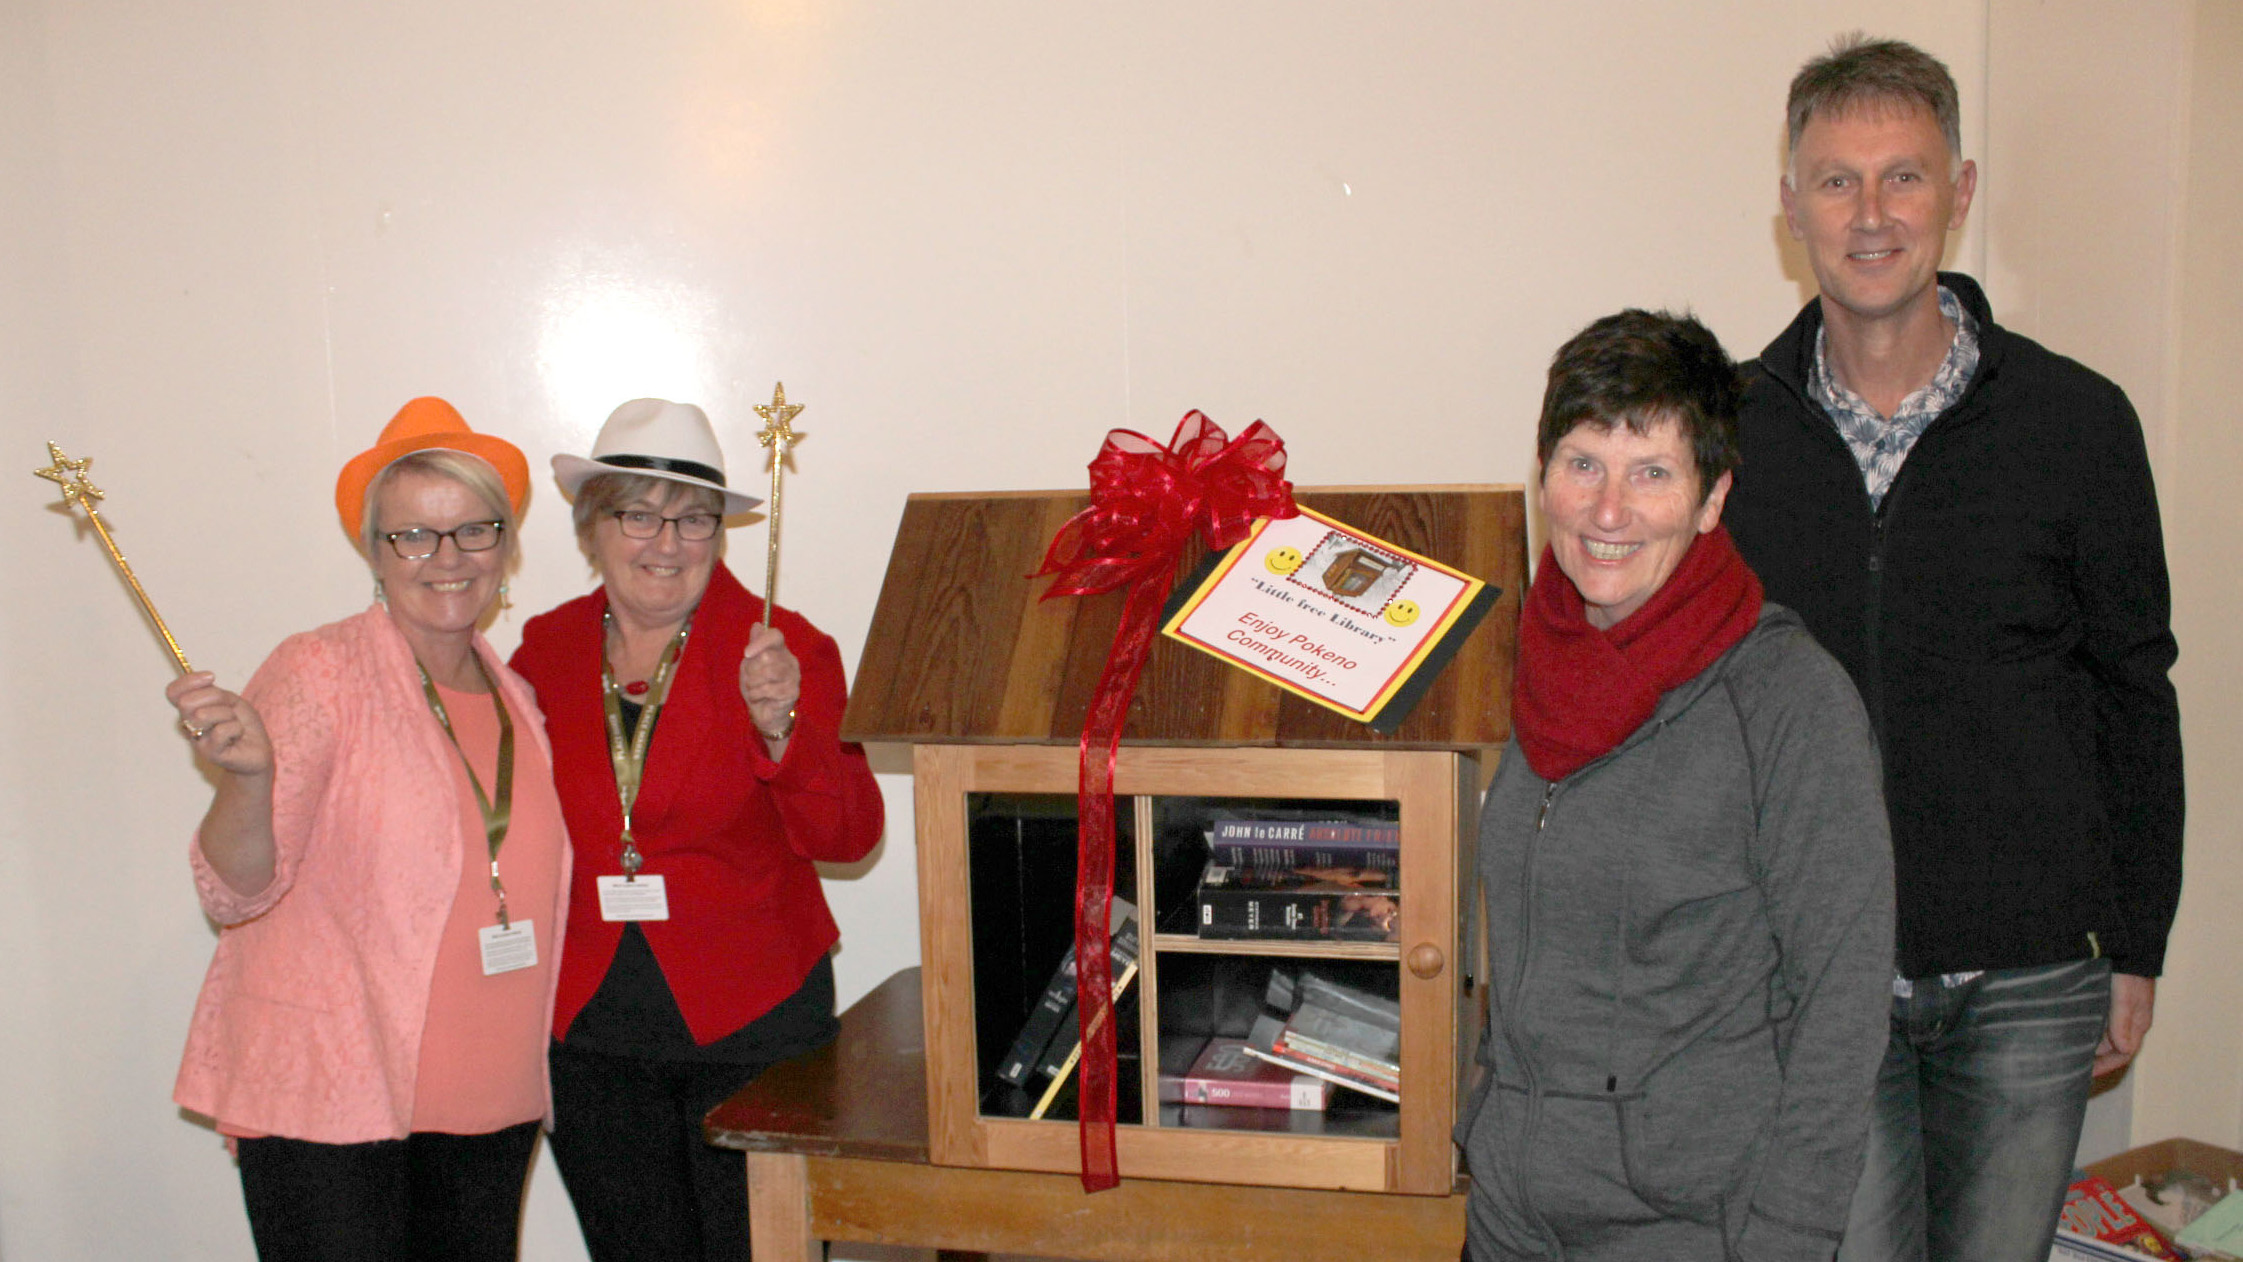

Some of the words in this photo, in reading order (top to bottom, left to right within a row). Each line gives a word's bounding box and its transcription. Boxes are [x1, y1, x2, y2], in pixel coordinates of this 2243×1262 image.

[1297, 598, 1326, 617] free
[1226, 629, 1336, 687] Community...
[1238, 611, 1290, 640] Enjoy
[1288, 634, 1358, 670] Pokeno
[1221, 825, 1252, 839] JOHN
[1254, 826, 1266, 839] le
[1267, 823, 1305, 841] CARRÉ
[2059, 1190, 2137, 1237] OPLE
